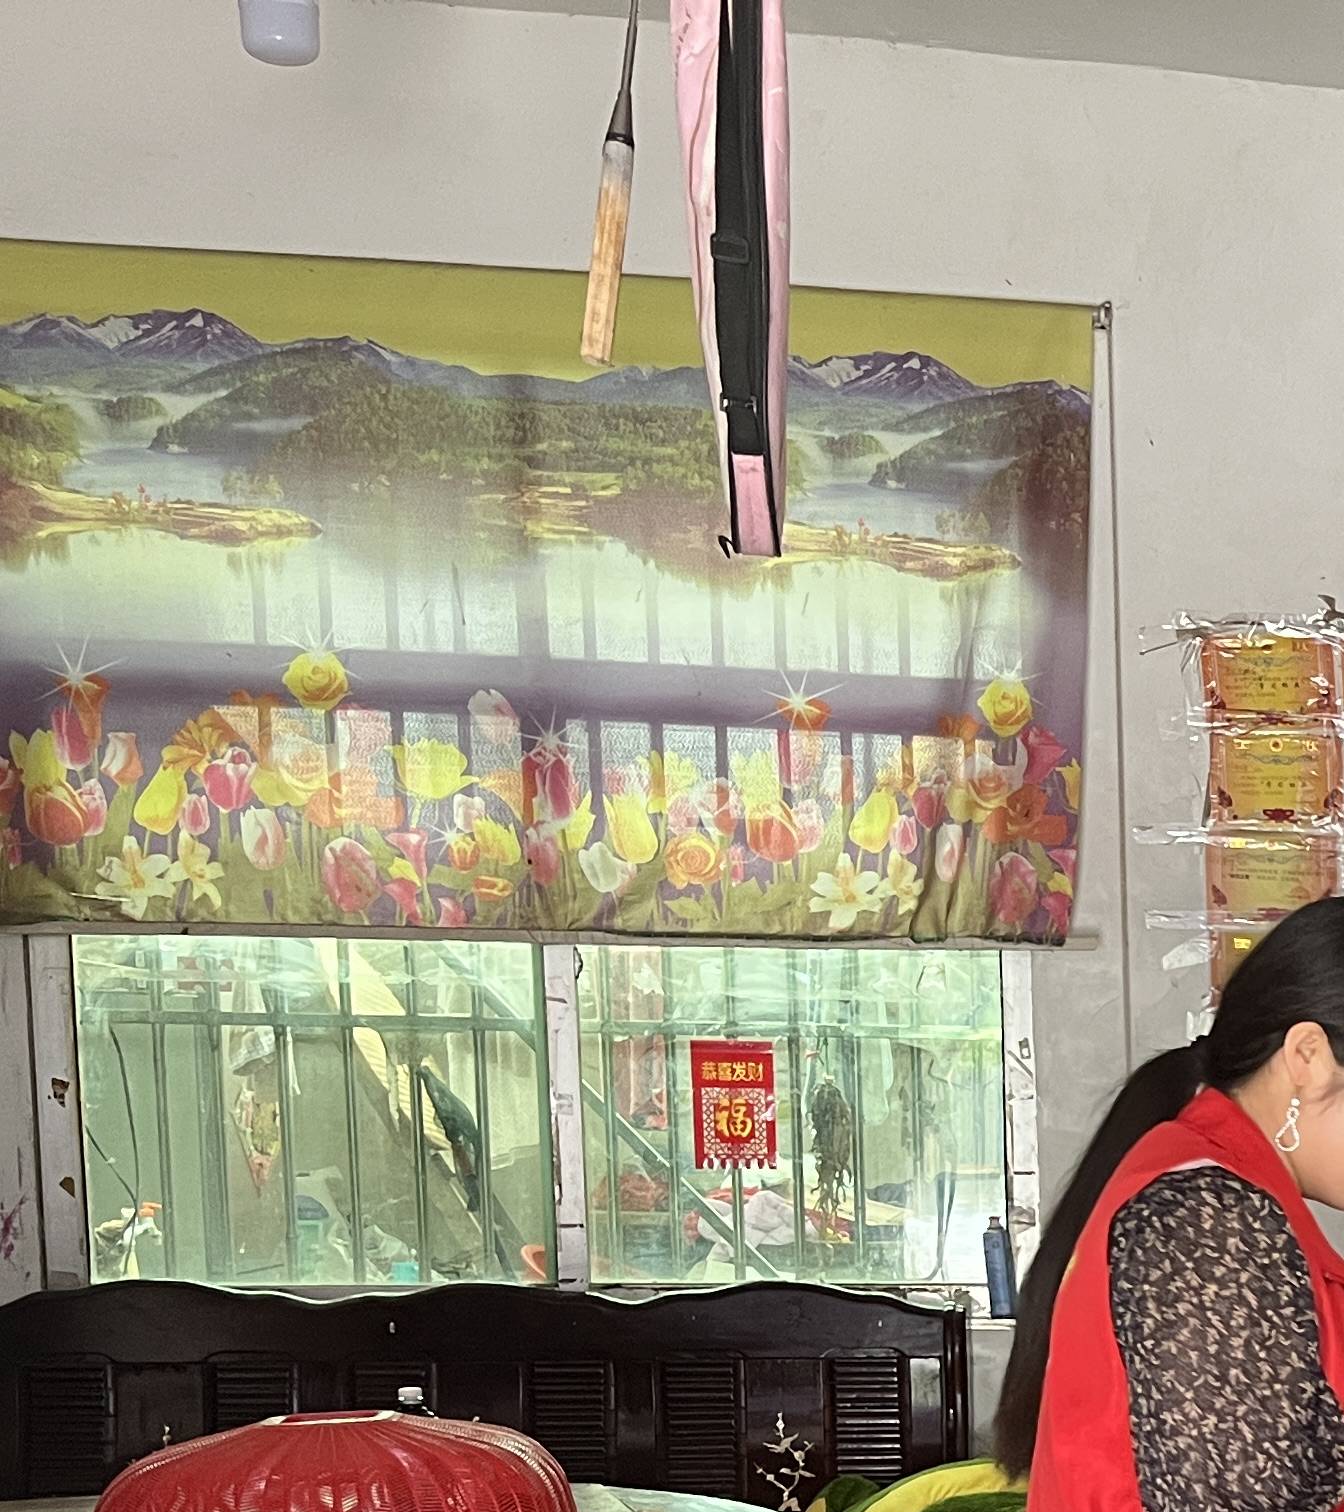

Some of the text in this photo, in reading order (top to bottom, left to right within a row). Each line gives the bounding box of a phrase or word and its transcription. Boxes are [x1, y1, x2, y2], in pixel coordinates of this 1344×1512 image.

[701, 1061, 763, 1082] 恭喜发财
[715, 1096, 753, 1138] 福
